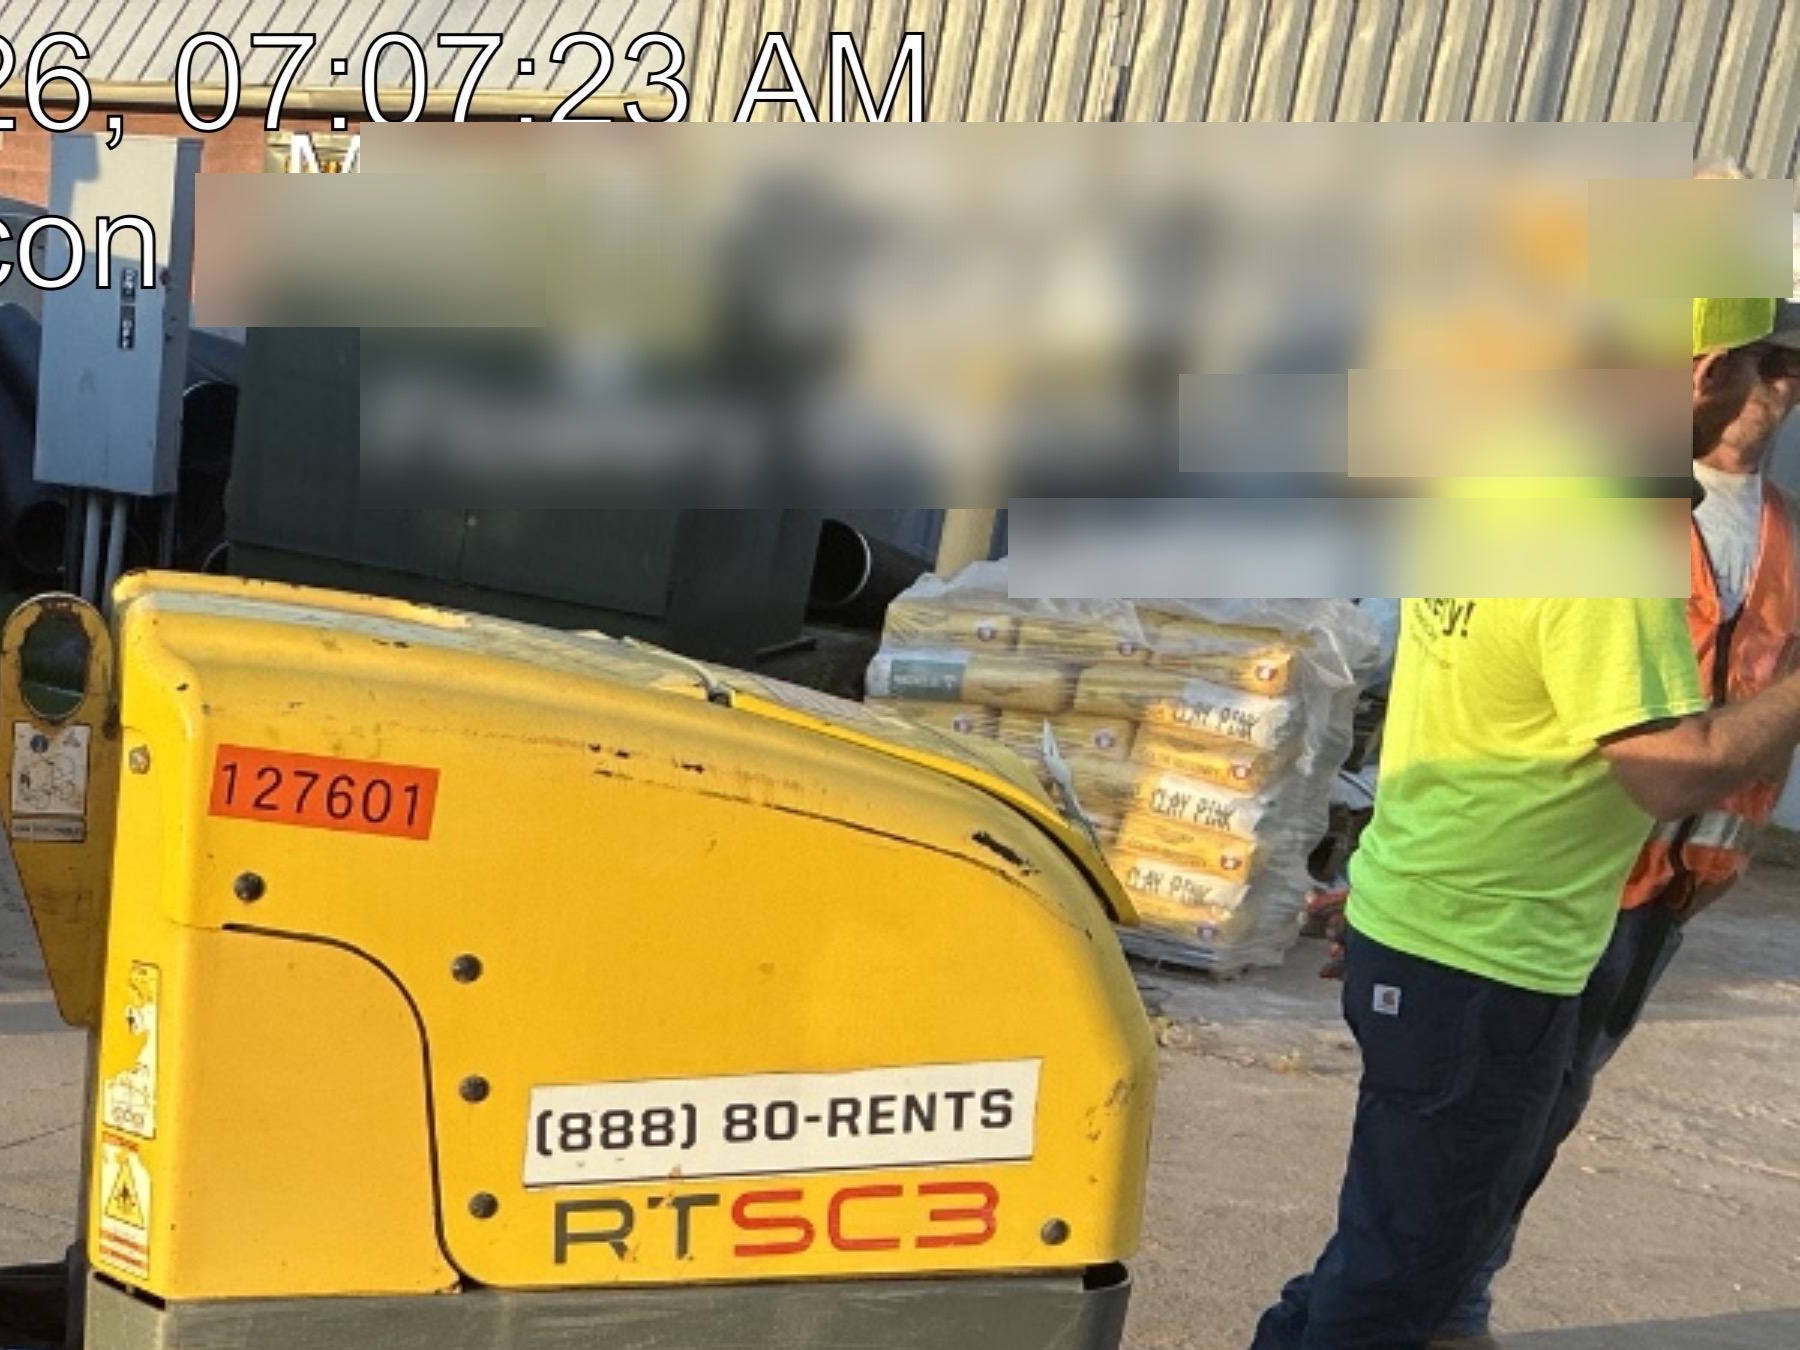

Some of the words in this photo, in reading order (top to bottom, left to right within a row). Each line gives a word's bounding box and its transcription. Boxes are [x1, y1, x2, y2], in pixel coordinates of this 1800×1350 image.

[222, 761, 420, 826] 127601
[1152, 788, 1192, 820] CLAY
[535, 1103, 697, 1156] (888)
[723, 1088, 1014, 1143] 80-RENTS
[554, 1181, 1000, 1265] RTSC3
